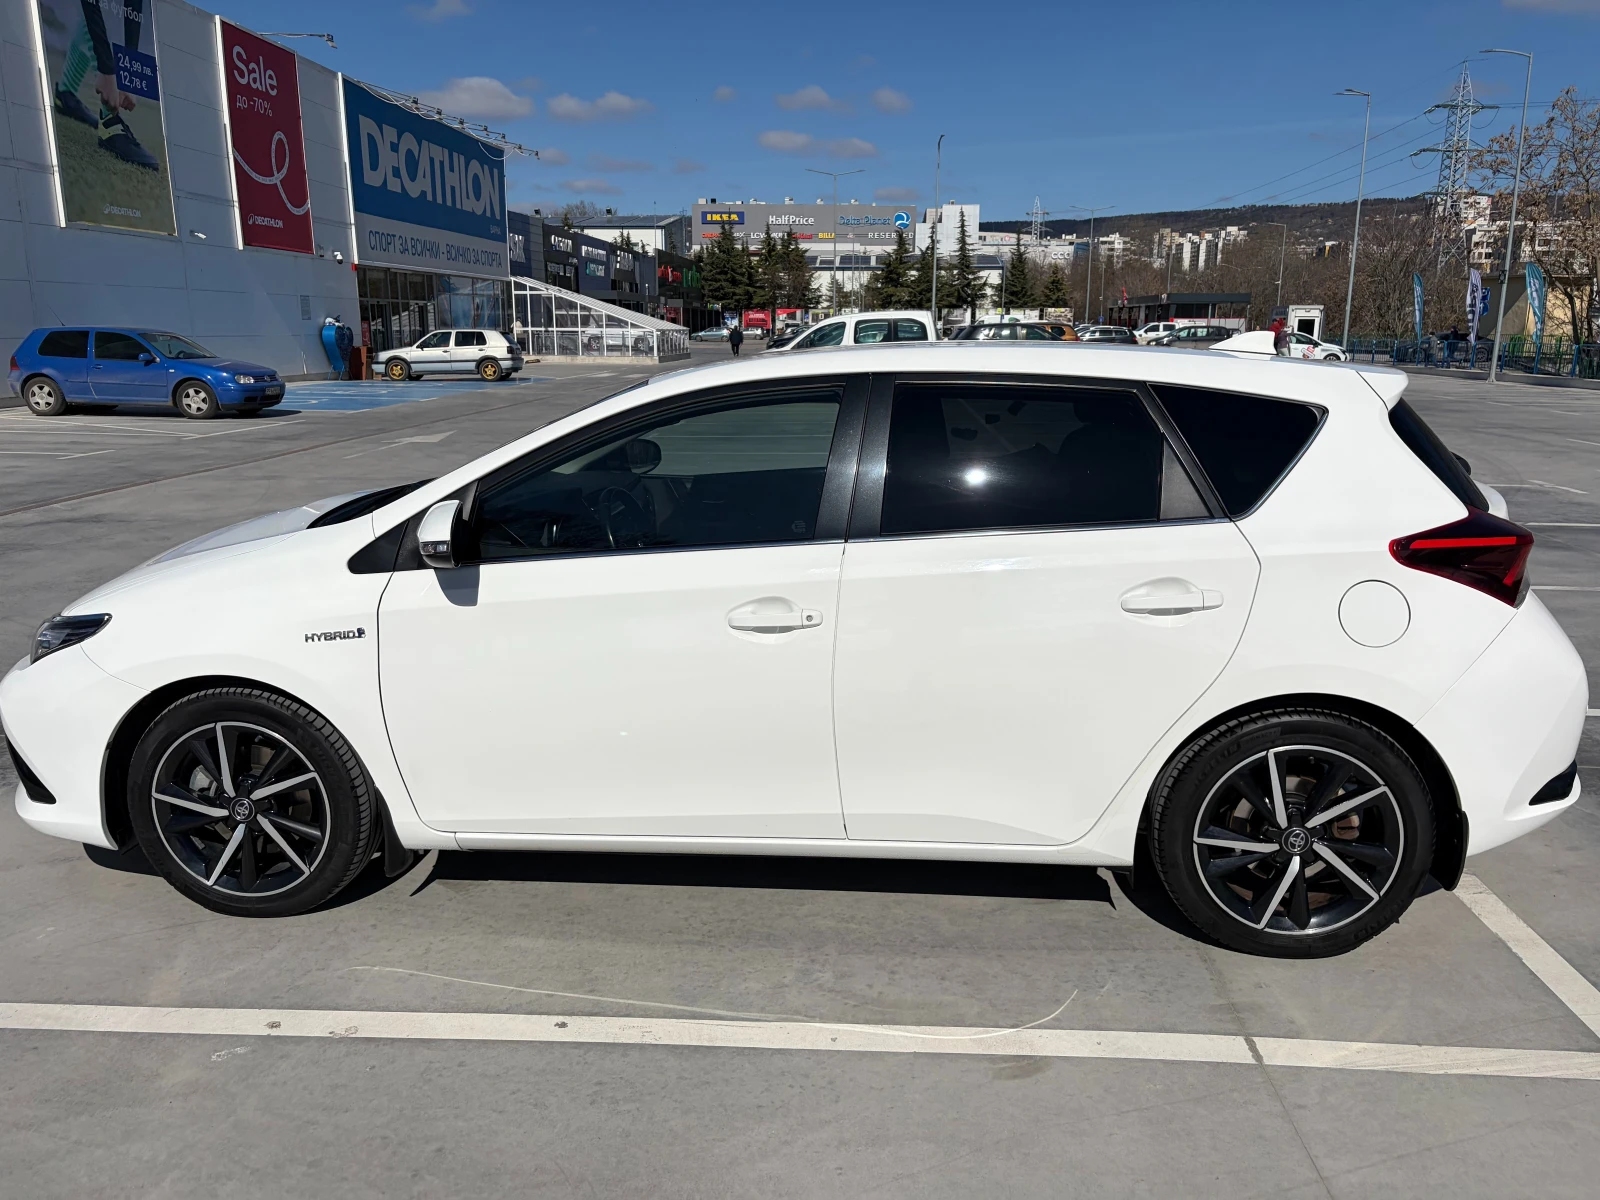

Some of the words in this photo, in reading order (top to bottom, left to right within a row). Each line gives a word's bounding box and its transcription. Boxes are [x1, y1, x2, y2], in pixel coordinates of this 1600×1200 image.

[118, 53, 142, 73] 24,99
[143, 66, 154, 77] лв.
[232, 45, 278, 96] Sale
[120, 70, 142, 89] 12,78
[142, 80, 148, 91] €
[236, 94, 248, 110] до
[249, 96, 273, 117] -70%
[358, 113, 501, 220] DECATHLON
[111, 206, 142, 218] DECATHLON
[706, 213, 739, 221] IKEA
[769, 214, 815, 225] HalfPrice
[839, 215, 861, 226] Delta
[863, 215, 891, 226] Planet
[254, 215, 284, 229] DECATHLON
[368, 230, 396, 253] СПОРТ
[398, 235, 409, 255] ЗА
[411, 237, 440, 260] ВСИЧКИ
[446, 243, 471, 264] ВСИЧКО
[472, 248, 481, 266] ЗА
[480, 249, 503, 269] СПОРТА
[304, 630, 356, 643] HYBRID
